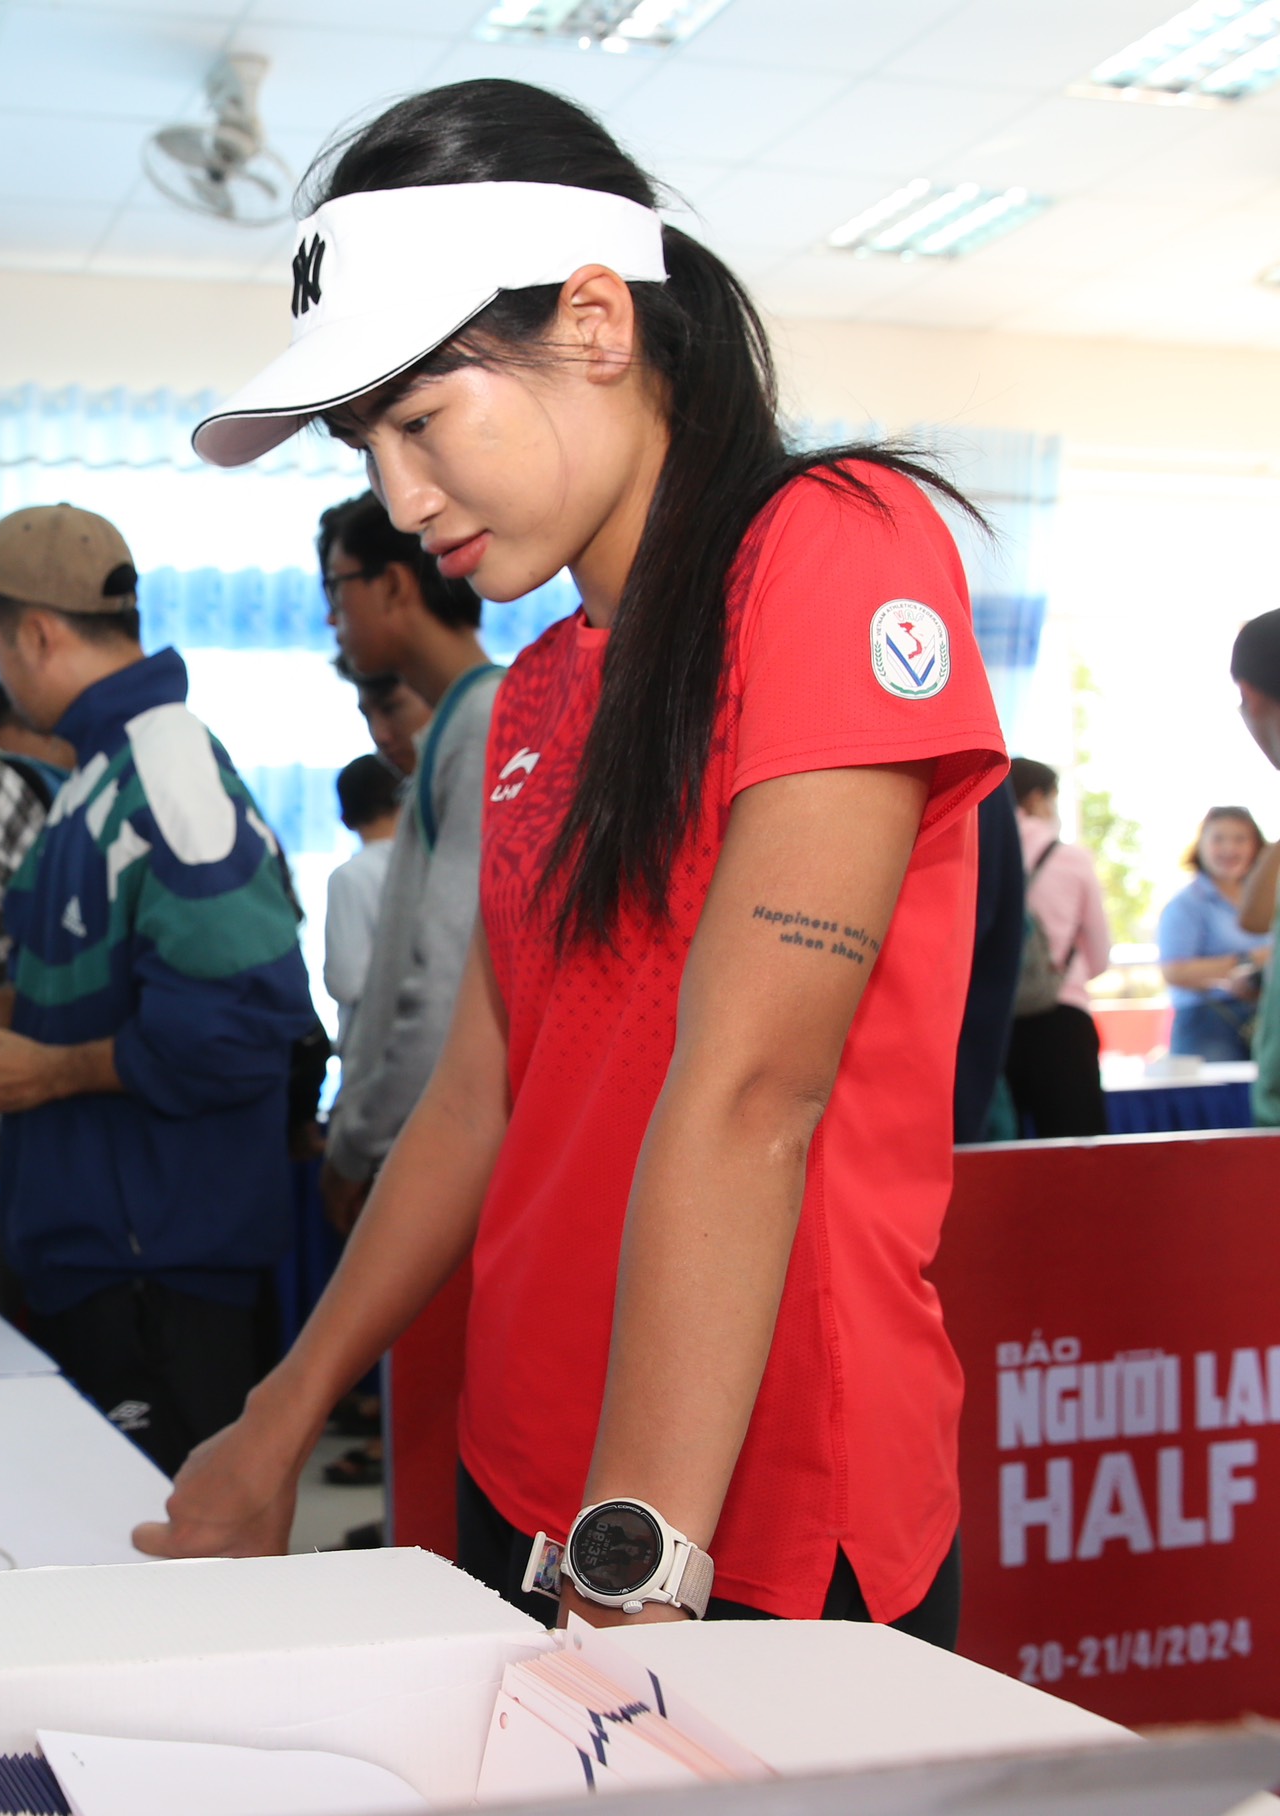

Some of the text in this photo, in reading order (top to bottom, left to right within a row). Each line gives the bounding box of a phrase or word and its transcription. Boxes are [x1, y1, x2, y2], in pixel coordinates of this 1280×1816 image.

[291, 231, 326, 318] NY
[752, 905, 838, 932] Happiness
[843, 928, 869, 946] only
[780, 931, 824, 950] when
[997, 1329, 1080, 1367] BÁO
[617, 1504, 641, 1514] COROS
[999, 1439, 1258, 1568] HALF
[1019, 1616, 1252, 1684] 20-21/4/2024
